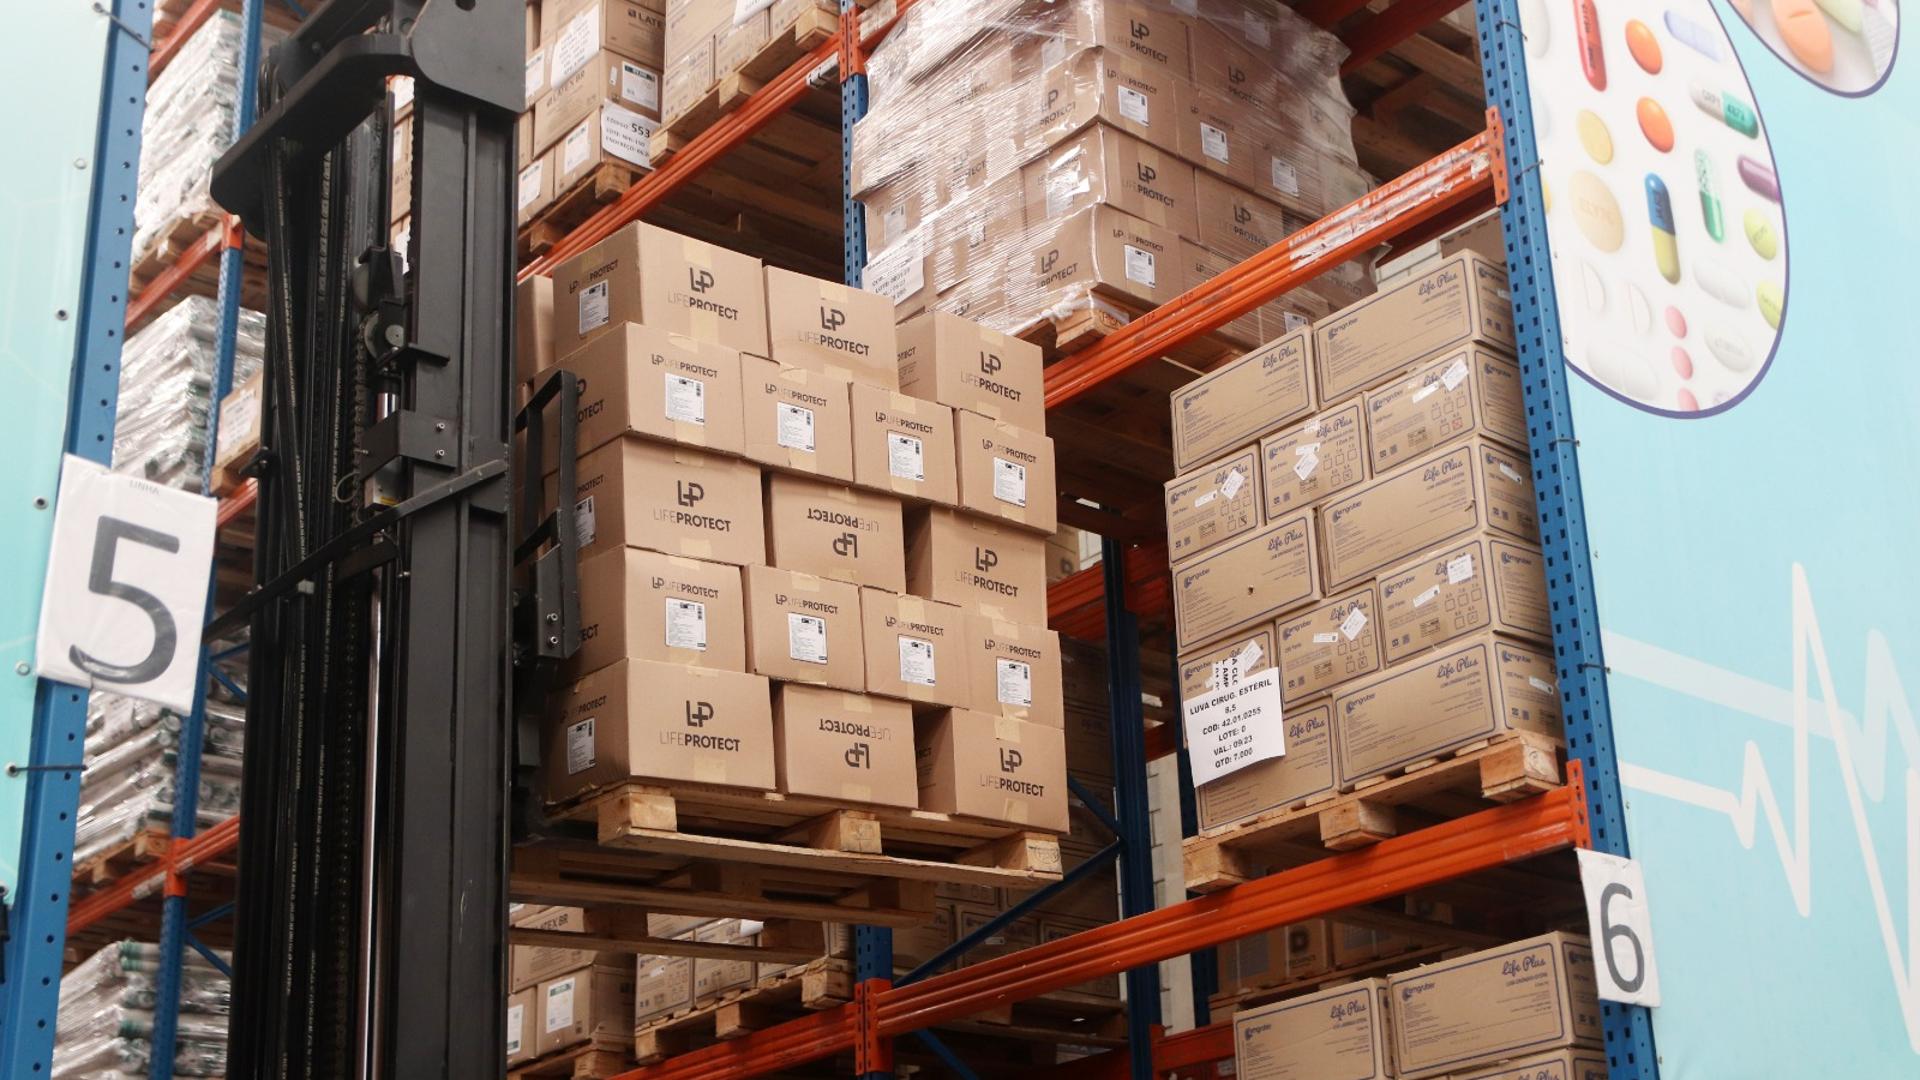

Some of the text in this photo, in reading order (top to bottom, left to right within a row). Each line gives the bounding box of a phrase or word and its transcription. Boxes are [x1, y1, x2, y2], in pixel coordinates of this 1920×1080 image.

[638, 11, 666, 28] LATE
[631, 123, 650, 139] 553
[653, 508, 731, 532] LIFEPROTECT
[69, 515, 180, 685] 5
[1437, 656, 1478, 678] Life Plus
[1189, 702, 1211, 716] LUVA
[659, 724, 740, 752] LIFEPROTECT
[1202, 723, 1220, 735] COD:
[1218, 728, 1239, 741] LOTE:
[1600, 882, 1645, 994] 6
[1502, 954, 1546, 977] Life Plus
